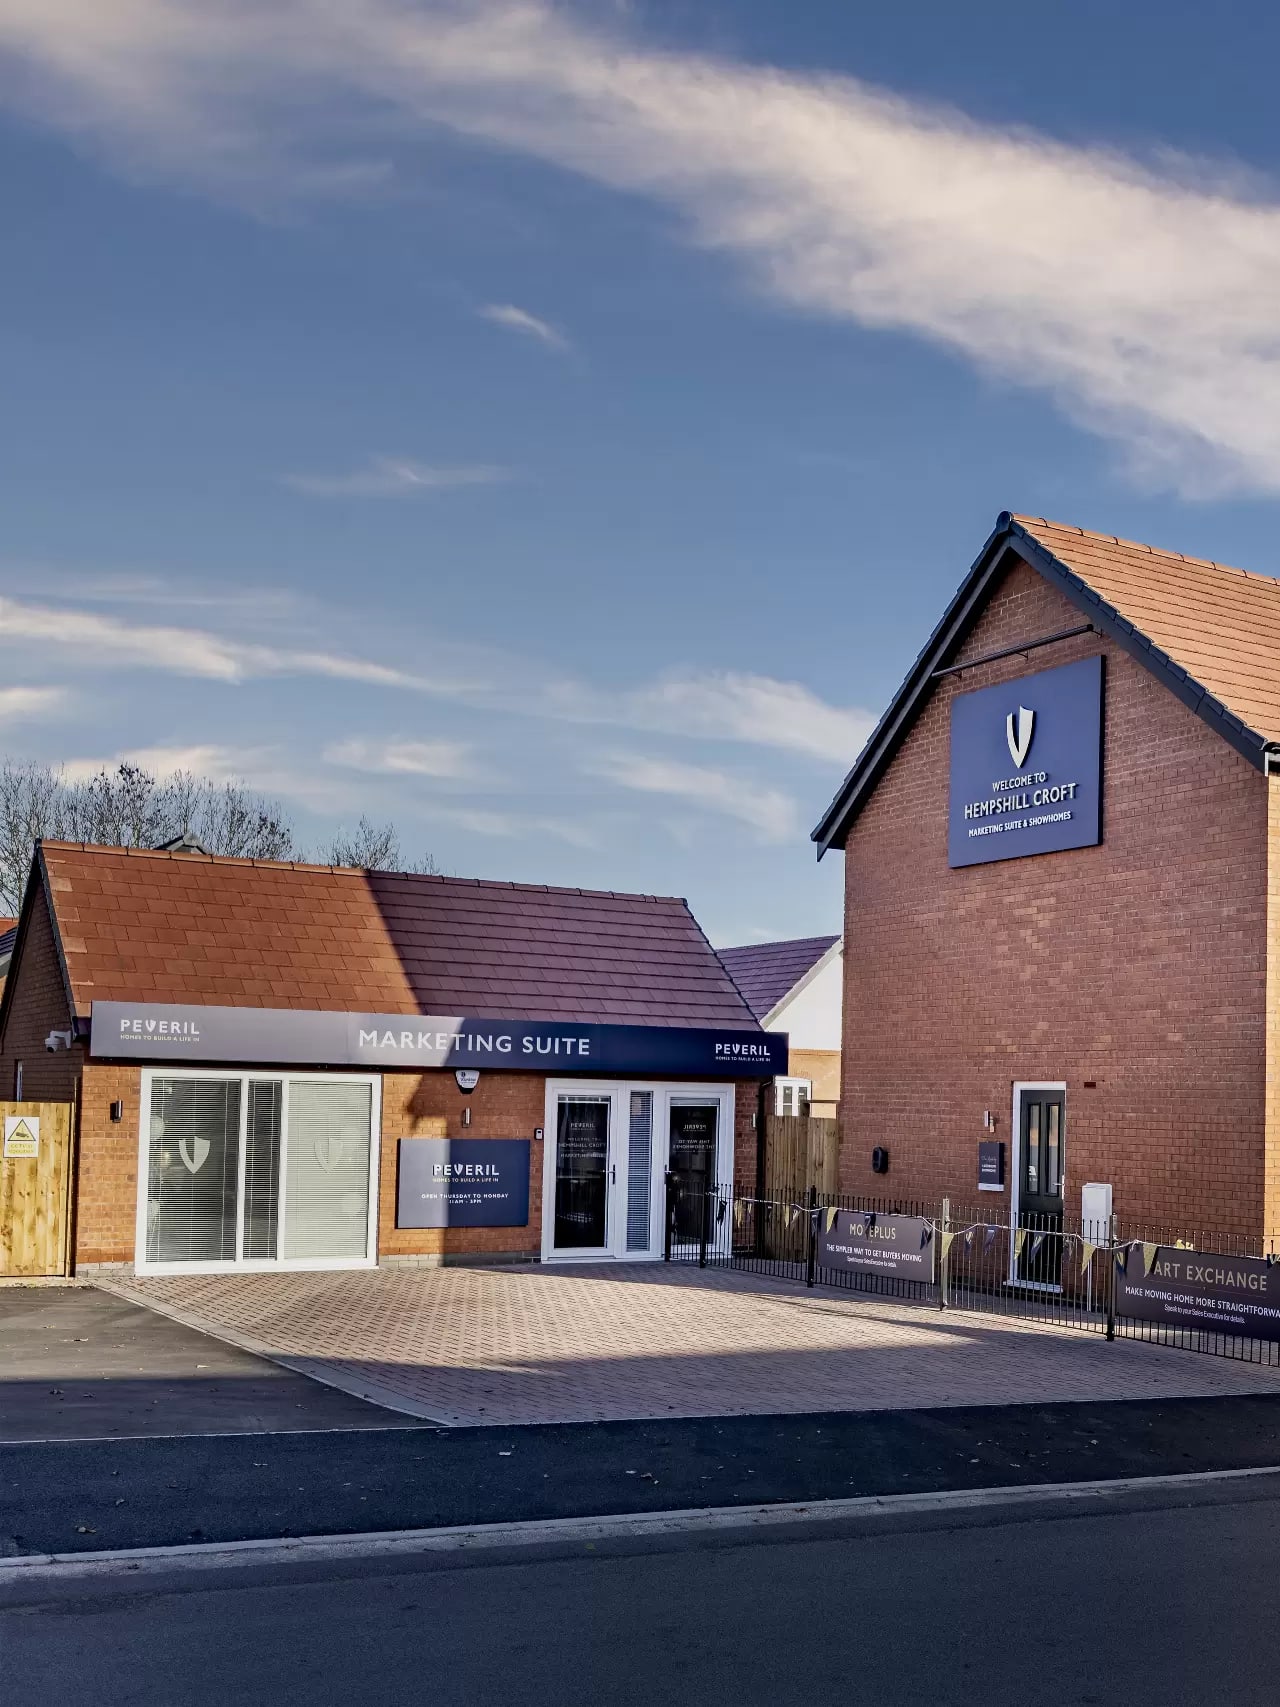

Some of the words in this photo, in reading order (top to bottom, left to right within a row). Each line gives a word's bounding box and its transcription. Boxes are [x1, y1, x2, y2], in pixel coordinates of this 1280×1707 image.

[992, 774, 1032, 792] WELCOME
[1033, 771, 1046, 784] TO
[964, 793, 1029, 820] HEMPSHILL
[1033, 783, 1076, 806] CROFT
[968, 824, 1003, 837] MARKETING
[1004, 820, 1022, 831] SUITE
[1023, 819, 1028, 828] &
[1029, 811, 1071, 826] SHOWHOMES
[120, 1019, 200, 1035] PEVERIL
[359, 1029, 512, 1053] MARKETING
[522, 1036, 590, 1055] SUITE
[715, 1043, 771, 1056] PEVERIL
[432, 1163, 500, 1176] PEVERIL
[849, 1223, 896, 1240] MOEPLUS
[826, 1243, 835, 1252] THE
[835, 1245, 853, 1254] SIMPLER
[853, 1247, 863, 1255] WAY
[865, 1248, 872, 1256] TO
[872, 1249, 881, 1258] GET
[882, 1250, 900, 1260] BUYERS
[901, 1253, 922, 1263] MOVING
[1154, 1261, 1181, 1278] ART
[1186, 1265, 1268, 1291] EXCHANGE
[1125, 1286, 1143, 1297] MAKE
[1144, 1289, 1172, 1302] MOVING
[1174, 1293, 1194, 1305] HOME
[1196, 1296, 1216, 1309] MORE
